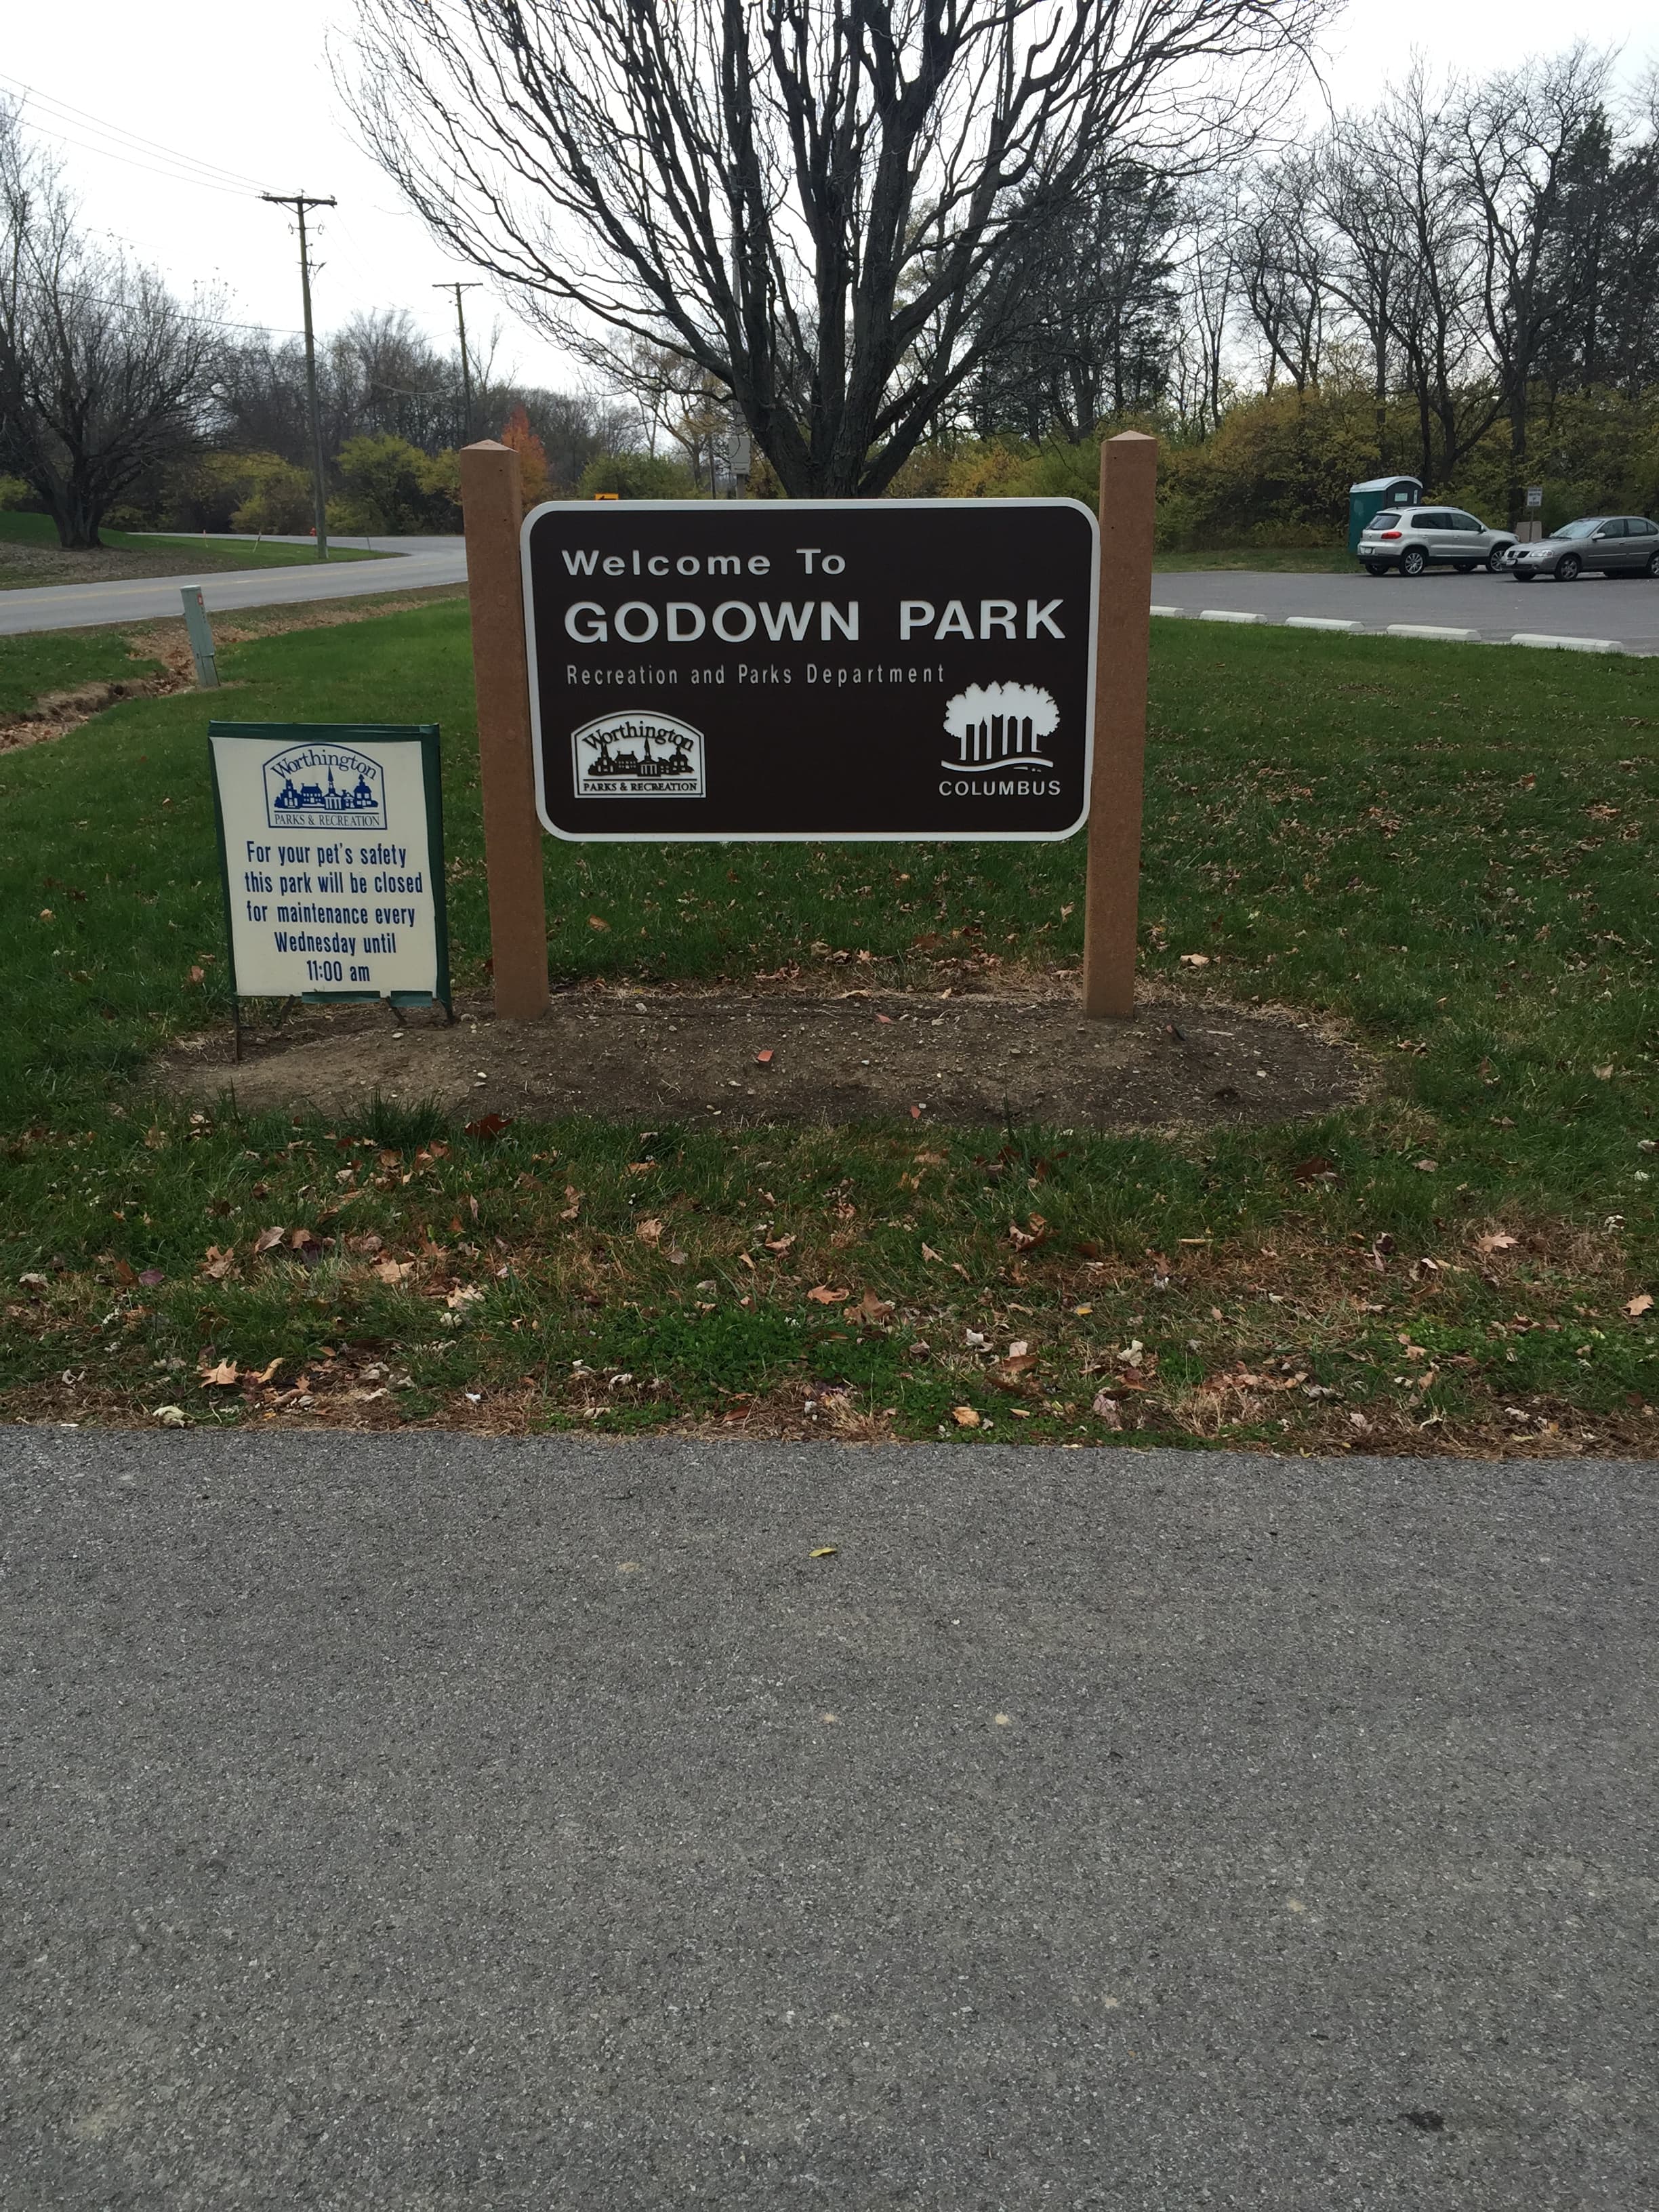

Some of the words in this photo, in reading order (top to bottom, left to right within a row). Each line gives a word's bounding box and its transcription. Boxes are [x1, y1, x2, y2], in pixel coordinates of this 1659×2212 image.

[562, 549, 771, 575] Welcome
[795, 548, 846, 575] To
[564, 600, 859, 643] GODOWN
[899, 598, 1066, 640] PARK
[567, 664, 678, 684] Recreation
[691, 664, 724, 684] and
[738, 663, 792, 684] Parks
[806, 663, 944, 687] Department
[582, 721, 693, 751] Worthington
[270, 750, 376, 779] Worthington
[584, 783, 616, 791] PARKS
[939, 780, 1061, 796] COLUMBUS
[274, 814, 304, 825] PARKS
[308, 815, 314, 825] &
[319, 815, 380, 826] RECREATION
[247, 840, 270, 862] For
[278, 846, 310, 866] your
[317, 843, 352, 867] pet's
[361, 843, 406, 867] safety
[245, 871, 272, 893] this
[279, 871, 312, 895] park
[318, 872, 344, 893] will
[350, 872, 367, 893] be
[374, 872, 423, 893] closed
[247, 900, 268, 922] for
[276, 902, 368, 924] maintenance
[375, 907, 415, 927] every
[274, 930, 356, 956] Wednesday
[363, 932, 396, 953] until
[306, 960, 343, 981] 11:00
[350, 965, 370, 981] am
